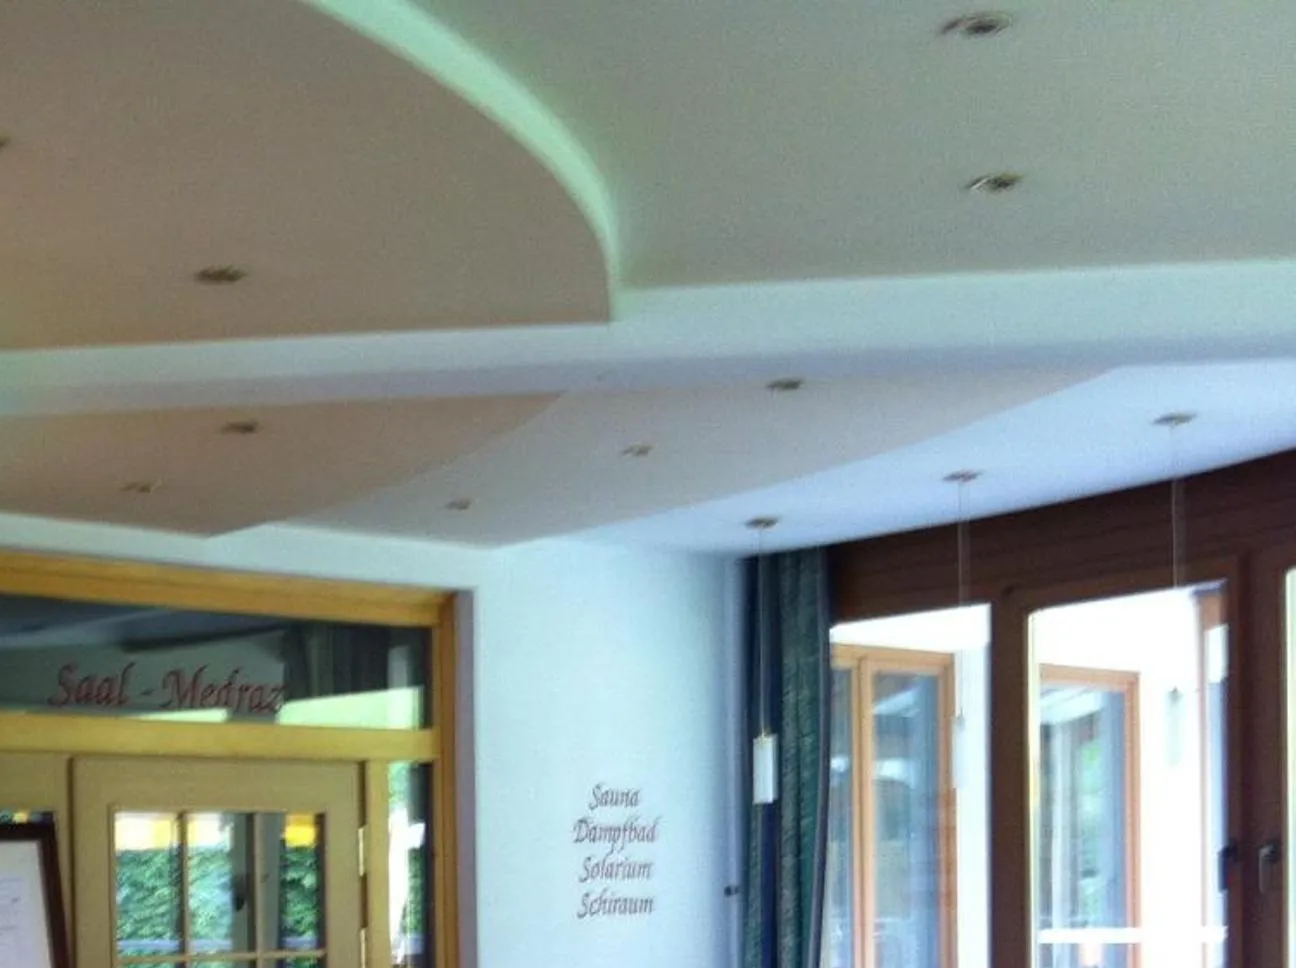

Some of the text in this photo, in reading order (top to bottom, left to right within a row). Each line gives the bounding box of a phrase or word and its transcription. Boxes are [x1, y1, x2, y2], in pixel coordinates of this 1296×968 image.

[48, 661, 137, 706] Saal
[158, 664, 287, 713] Medraz
[588, 782, 640, 811] Sauna
[573, 814, 662, 854] Dampfbad
[578, 854, 654, 883] Solarium
